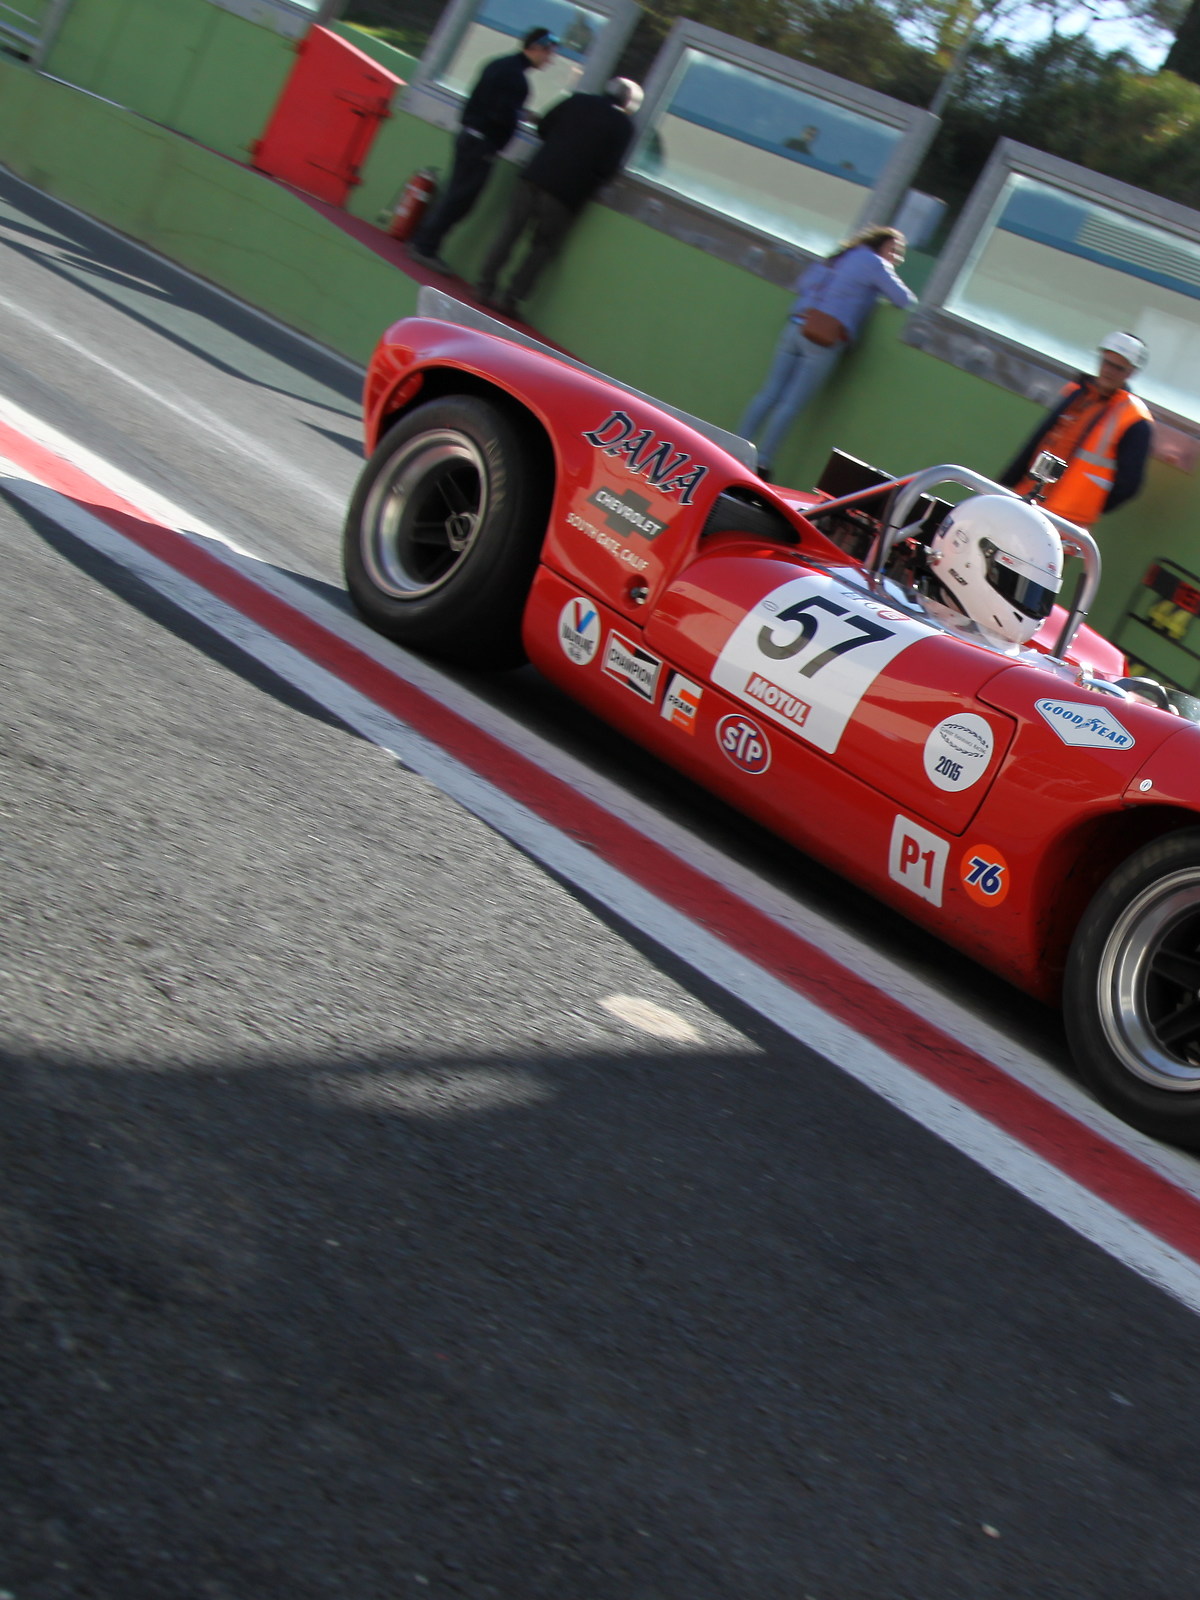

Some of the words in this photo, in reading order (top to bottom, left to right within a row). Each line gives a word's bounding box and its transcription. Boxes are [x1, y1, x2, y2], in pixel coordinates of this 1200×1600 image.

[582, 410, 709, 506] DANA
[566, 512, 599, 540] SOUTH
[595, 490, 661, 535] CHEVROLET
[756, 595, 897, 679] 57
[609, 648, 655, 687] CHAMPION
[669, 695, 693, 716] FRAM
[748, 677, 806, 724] MOTUL
[722, 722, 763, 763] STP
[934, 755, 964, 782] 2015
[900, 834, 935, 889] P1
[964, 855, 1005, 896] 76
